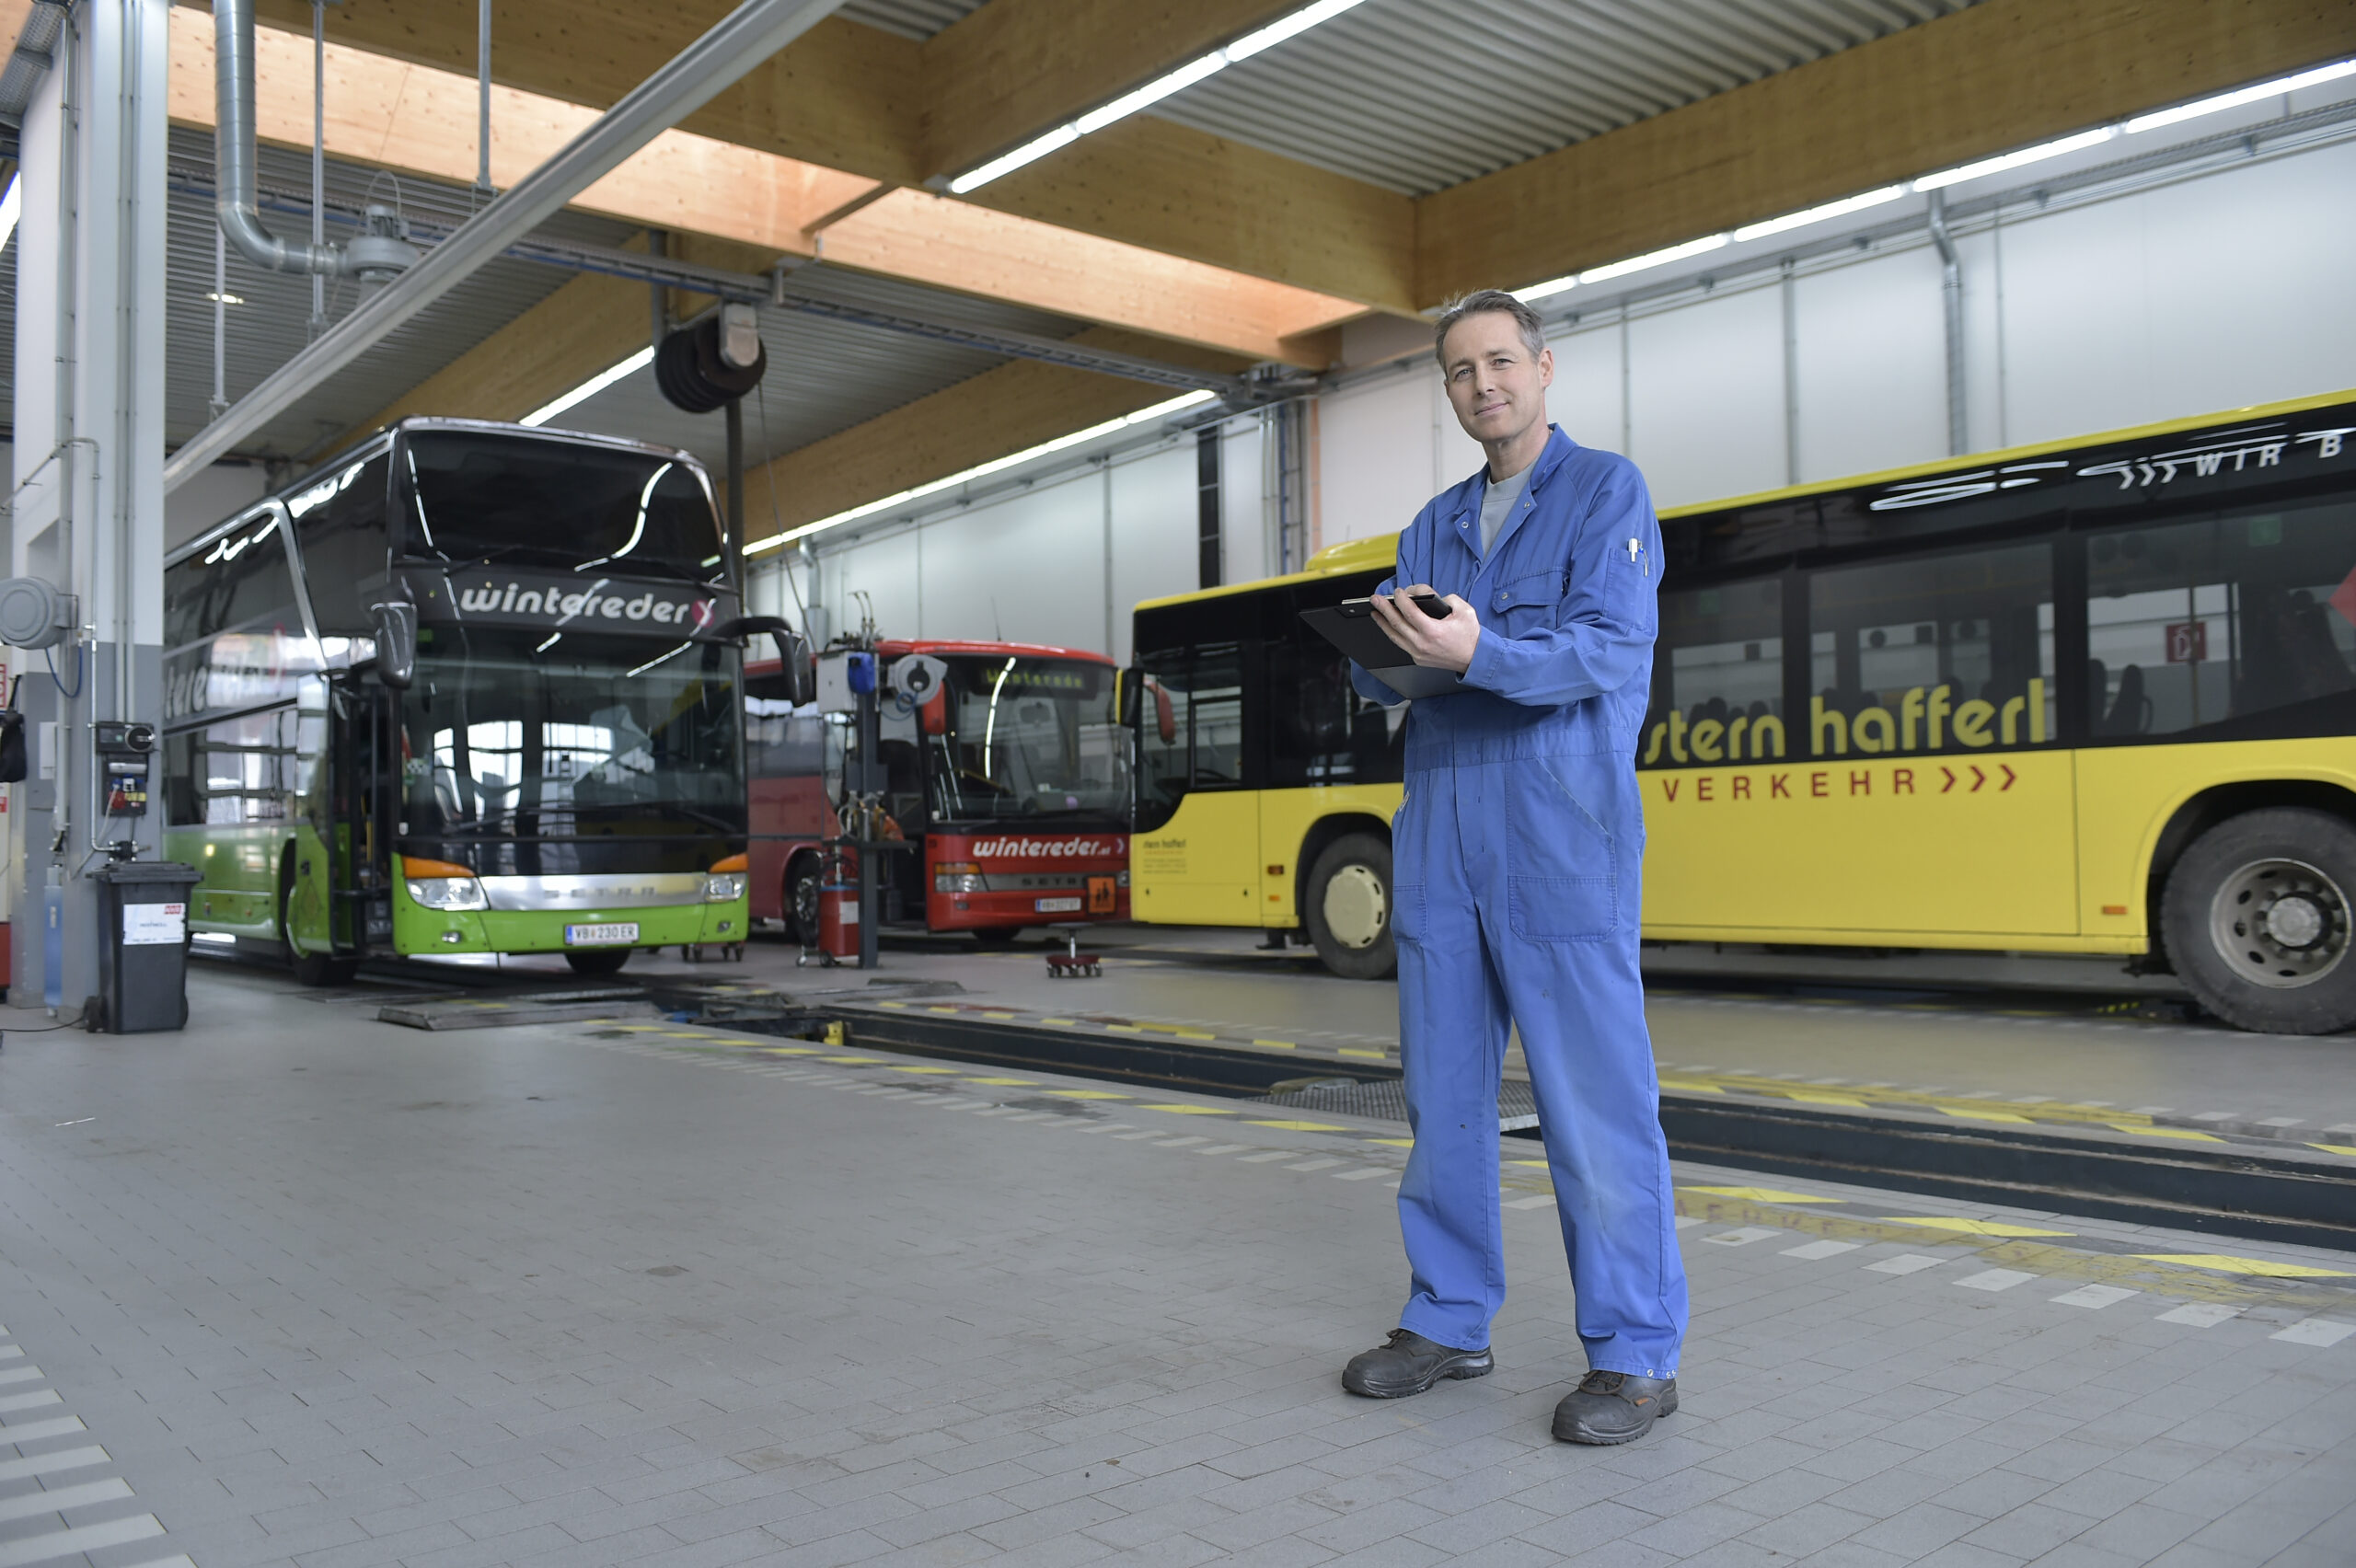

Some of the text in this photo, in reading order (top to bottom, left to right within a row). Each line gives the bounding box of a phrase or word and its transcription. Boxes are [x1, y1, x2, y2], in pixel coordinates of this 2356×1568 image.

[2196, 444, 2281, 478] WIR
[460, 582, 689, 625] wintereder
[1645, 678, 2046, 765] stern hafferl
[1663, 768, 1915, 801] VERKEHR
[574, 926, 590, 939] VB
